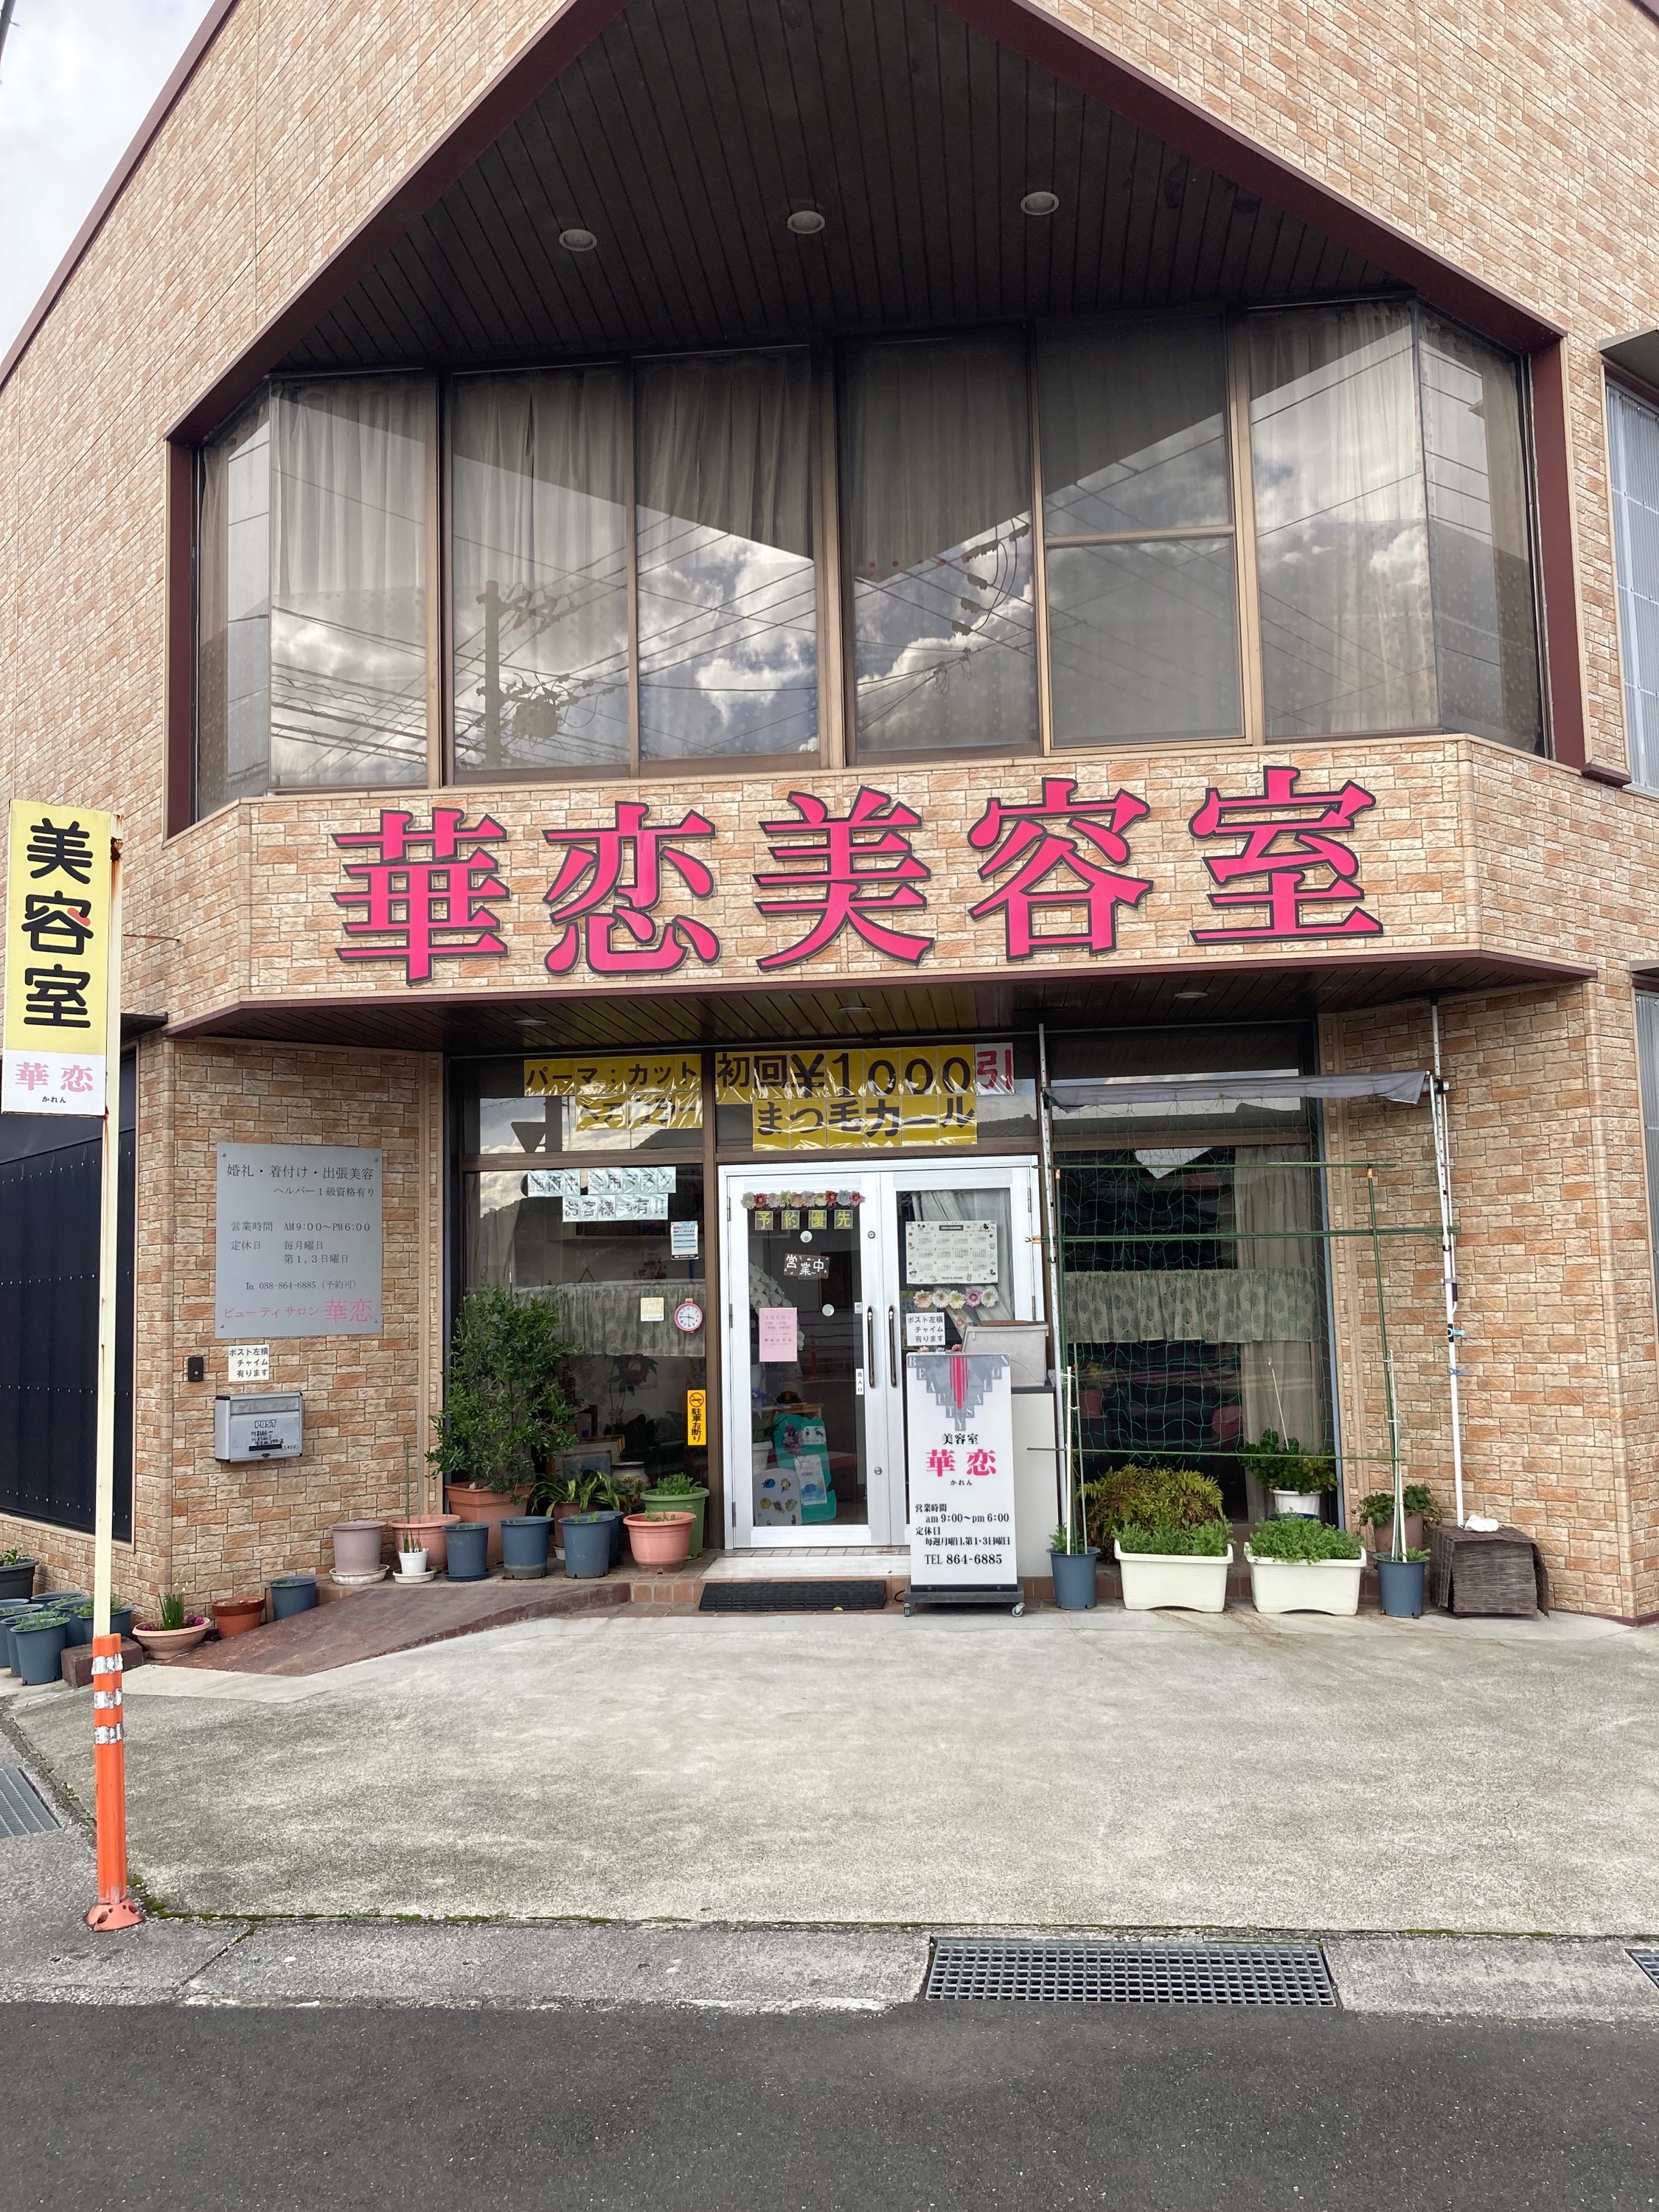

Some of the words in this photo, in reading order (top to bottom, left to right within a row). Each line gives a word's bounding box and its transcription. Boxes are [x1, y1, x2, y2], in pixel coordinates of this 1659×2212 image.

[330, 765, 1383, 986] 華恋美容室
[21, 817, 94, 1029] 美容室
[15, 1062, 94, 1093] 華恋
[42, 1096, 66, 1104] かれん
[757, 1096, 975, 1138] まつ毛カール
[226, 1164, 374, 1180] 婚礼・着付け・出張美容
[274, 1186, 375, 1197] ヘルパー1級資格有り
[757, 1211, 852, 1229] 予約優先
[230, 1221, 274, 1232] 営業時間
[231, 1240, 261, 1251] 定休日
[283, 1240, 323, 1251] 毎月曜日
[785, 1253, 824, 1276] 営業中
[224, 1305, 320, 1319] ビューティサロン
[324, 1298, 372, 1324] 華恋
[915, 1335, 944, 1343] 有ります
[237, 1359, 268, 1367] チャイム
[237, 1368, 268, 1378] 有ります
[254, 1419, 276, 1428] POST
[692, 1408, 702, 1442] 駐車お断り
[942, 1433, 978, 1445] 美容室
[925, 1448, 996, 1477] 華恋
[915, 1503, 947, 1513] 営業時間
[915, 1526, 941, 1536] 定休日
[925, 1554, 943, 1565] TEL
[946, 1554, 1003, 1565] 864-6885
